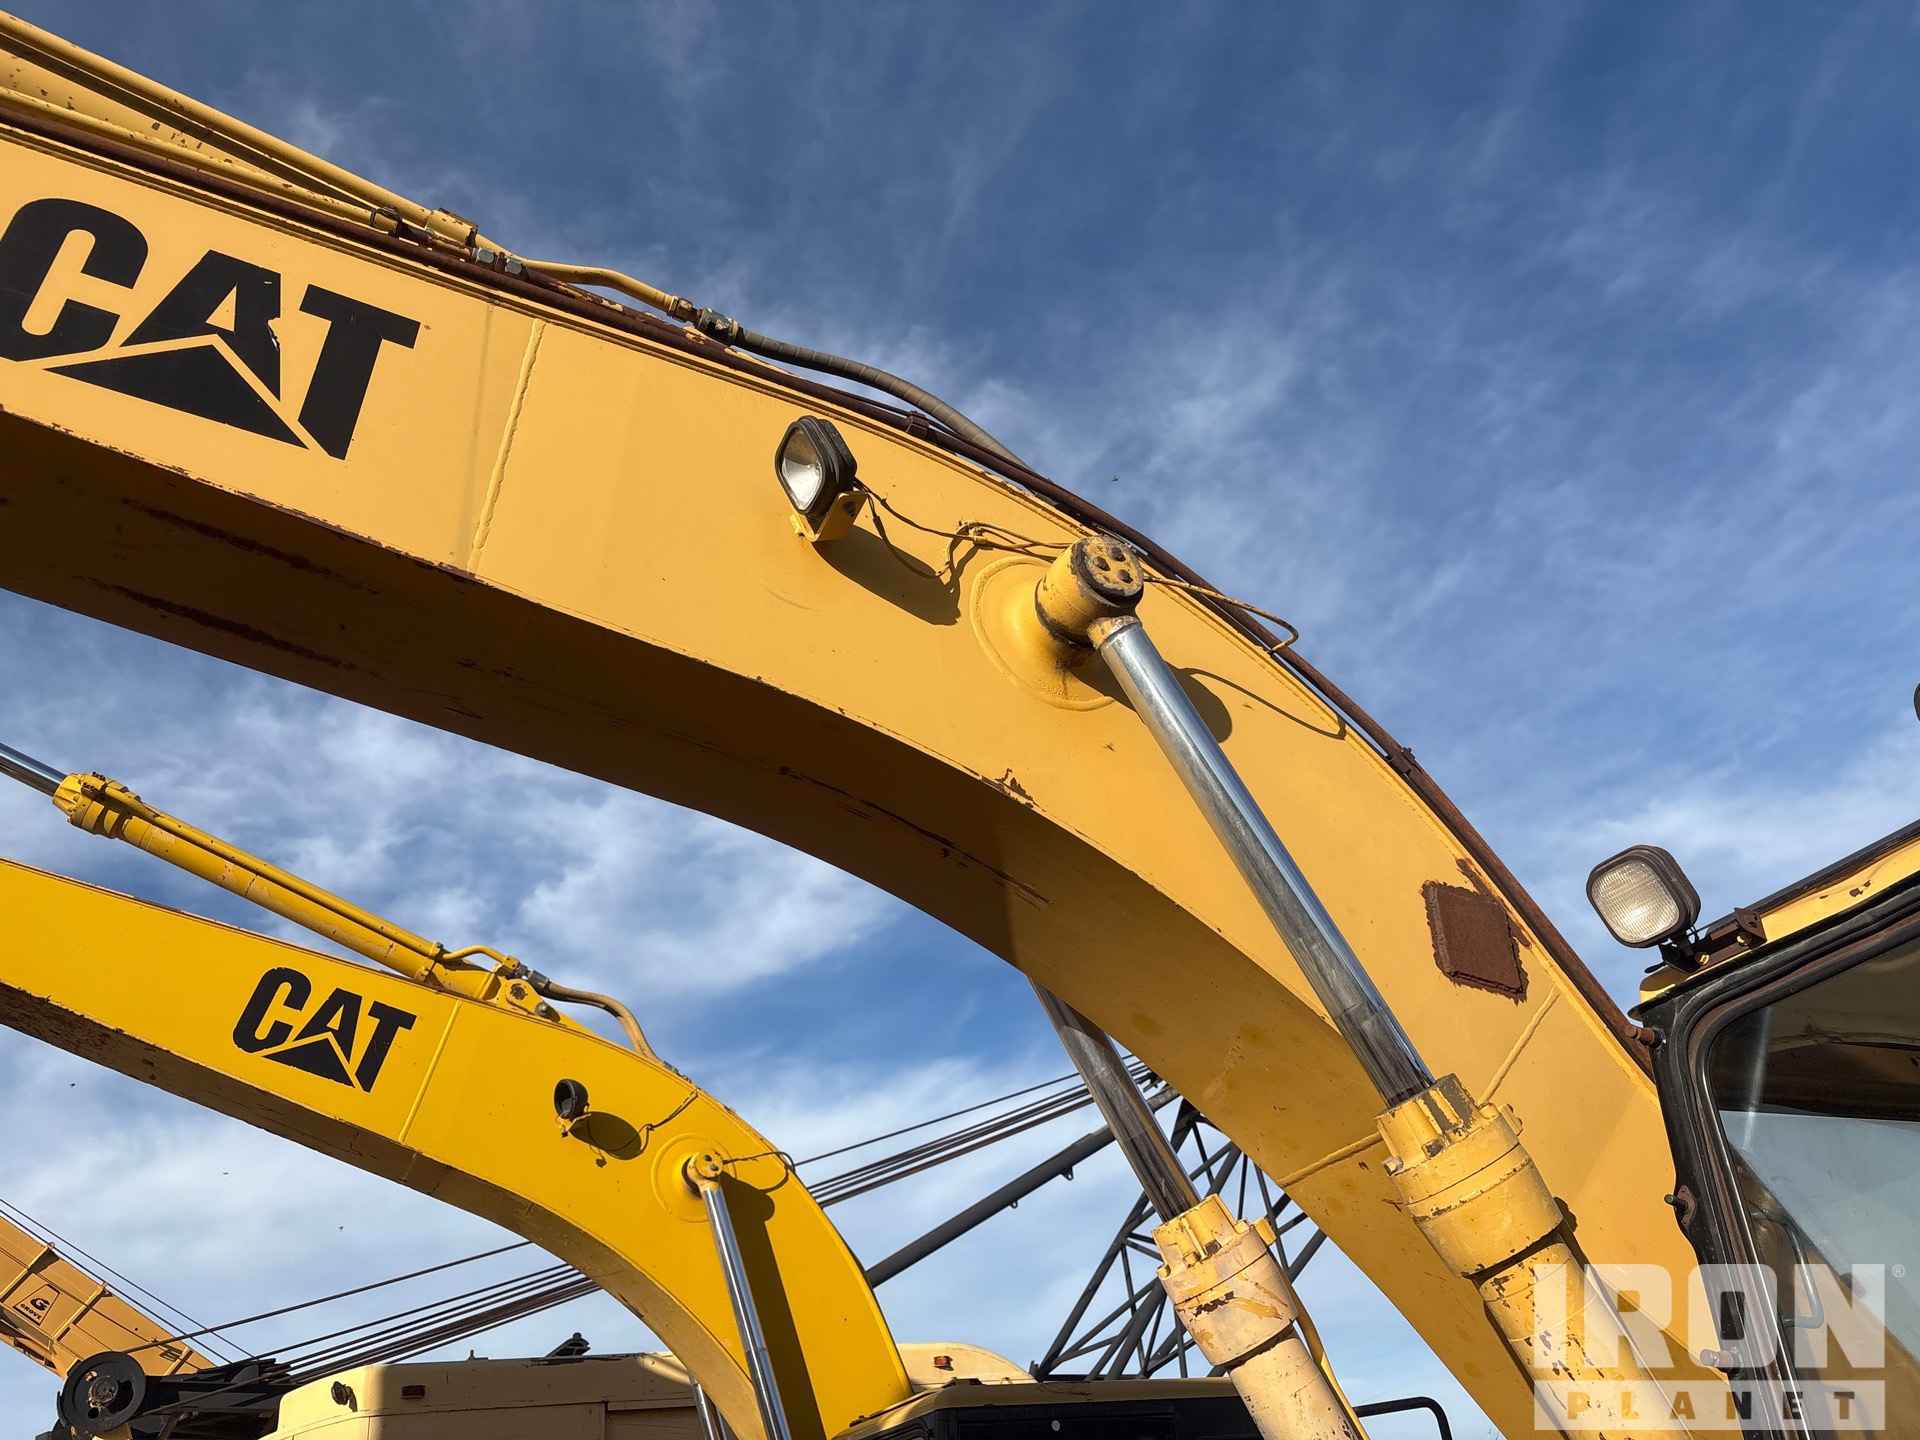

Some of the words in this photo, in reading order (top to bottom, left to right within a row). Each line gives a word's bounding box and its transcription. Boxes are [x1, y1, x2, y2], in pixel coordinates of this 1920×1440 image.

[0, 198, 421, 461] CAT
[232, 966, 418, 1094] CAT
[20, 1303, 42, 1320] GROVE
